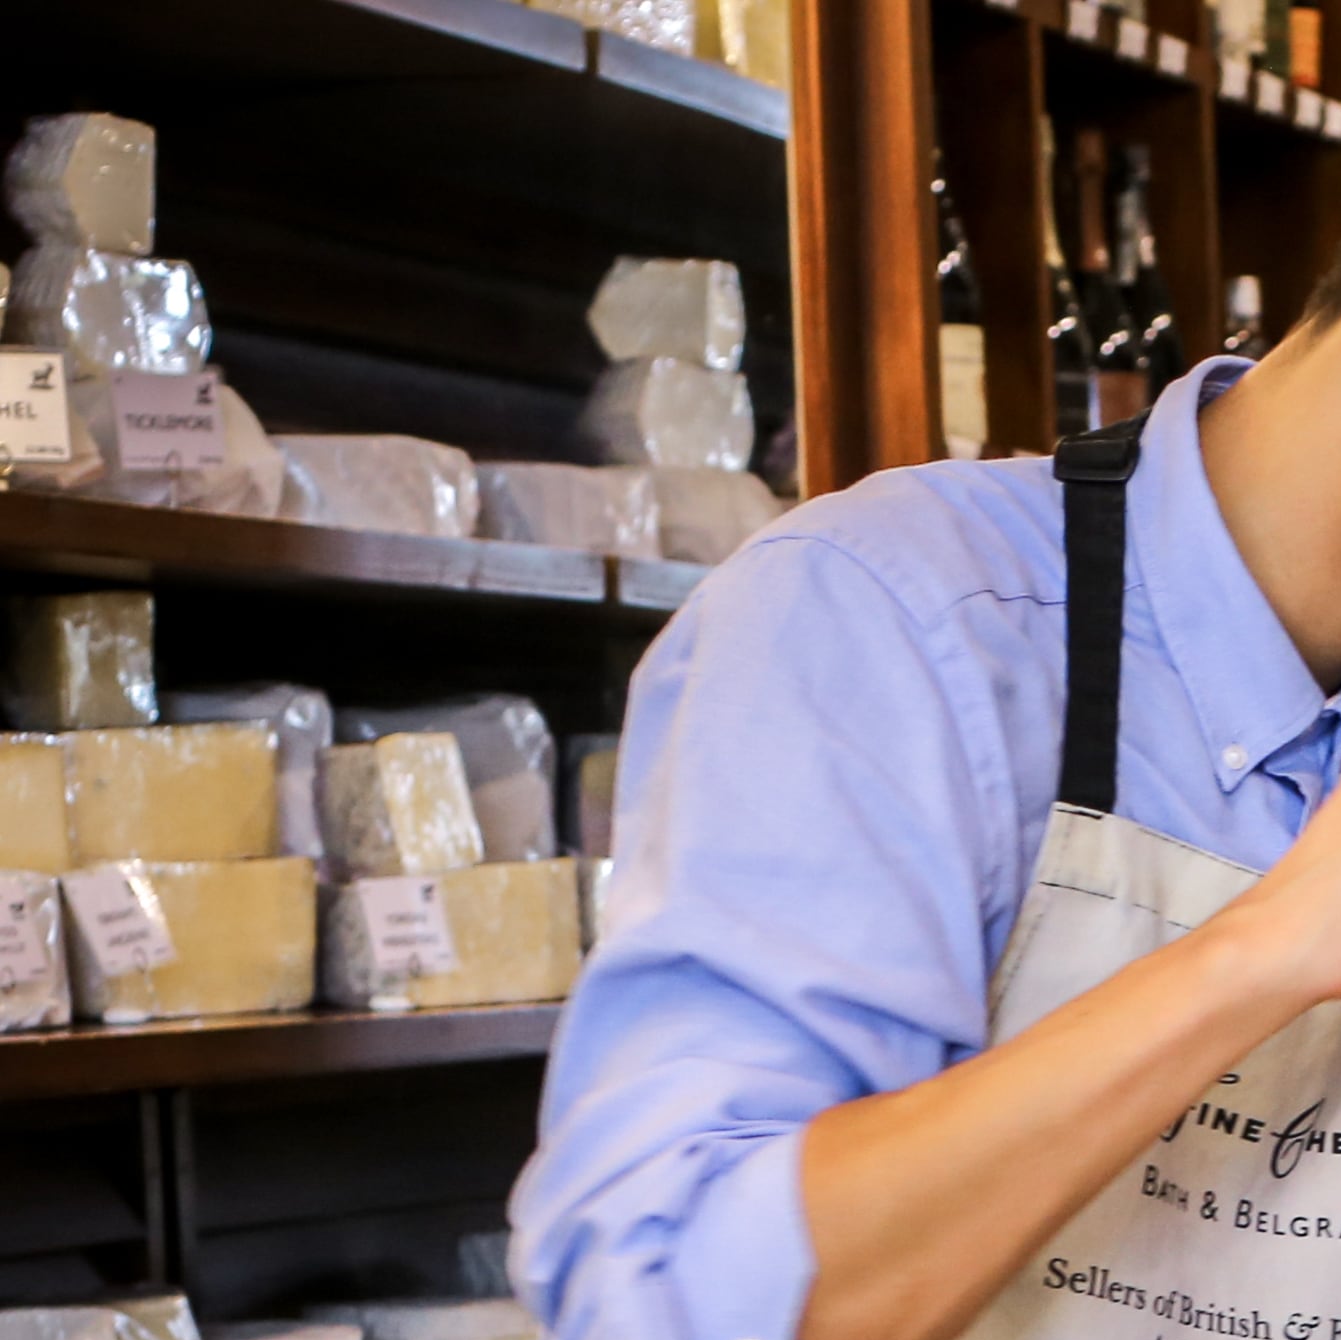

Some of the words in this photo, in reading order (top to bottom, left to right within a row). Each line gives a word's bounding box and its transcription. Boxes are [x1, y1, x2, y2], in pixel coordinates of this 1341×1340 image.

[1141, 1164, 1190, 1211] BATH
[1199, 1190, 1218, 1222] &
[1043, 1257, 1148, 1310] Sellers
[1153, 1290, 1178, 1320] of
[1178, 1294, 1273, 1340] British
